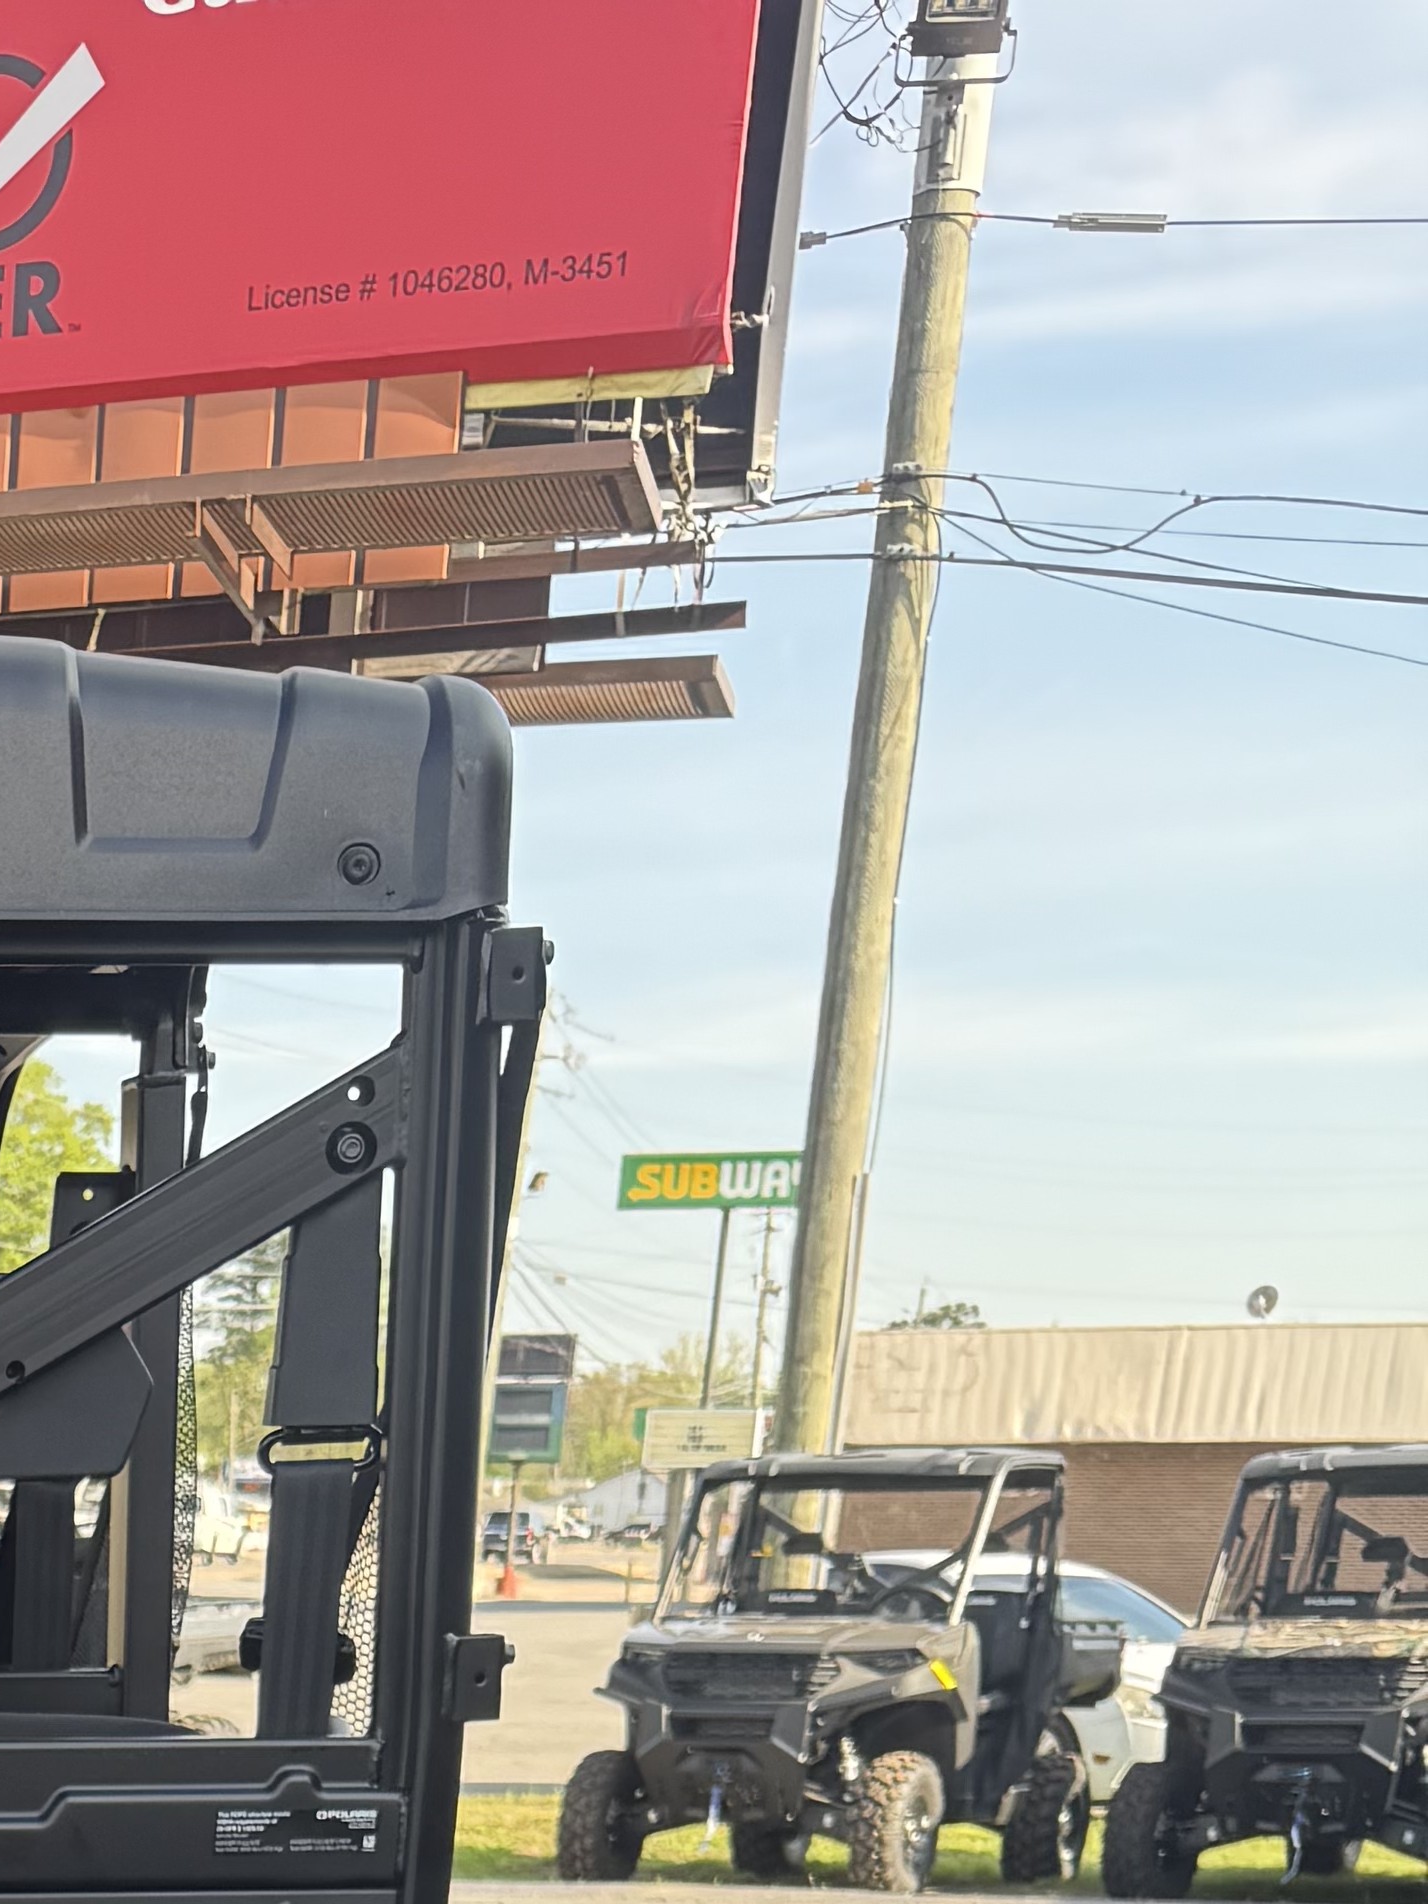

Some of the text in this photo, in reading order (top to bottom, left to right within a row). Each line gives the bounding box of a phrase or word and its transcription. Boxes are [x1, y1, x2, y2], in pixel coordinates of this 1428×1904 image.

[246, 250, 629, 312] License # 1046280, M-3451
